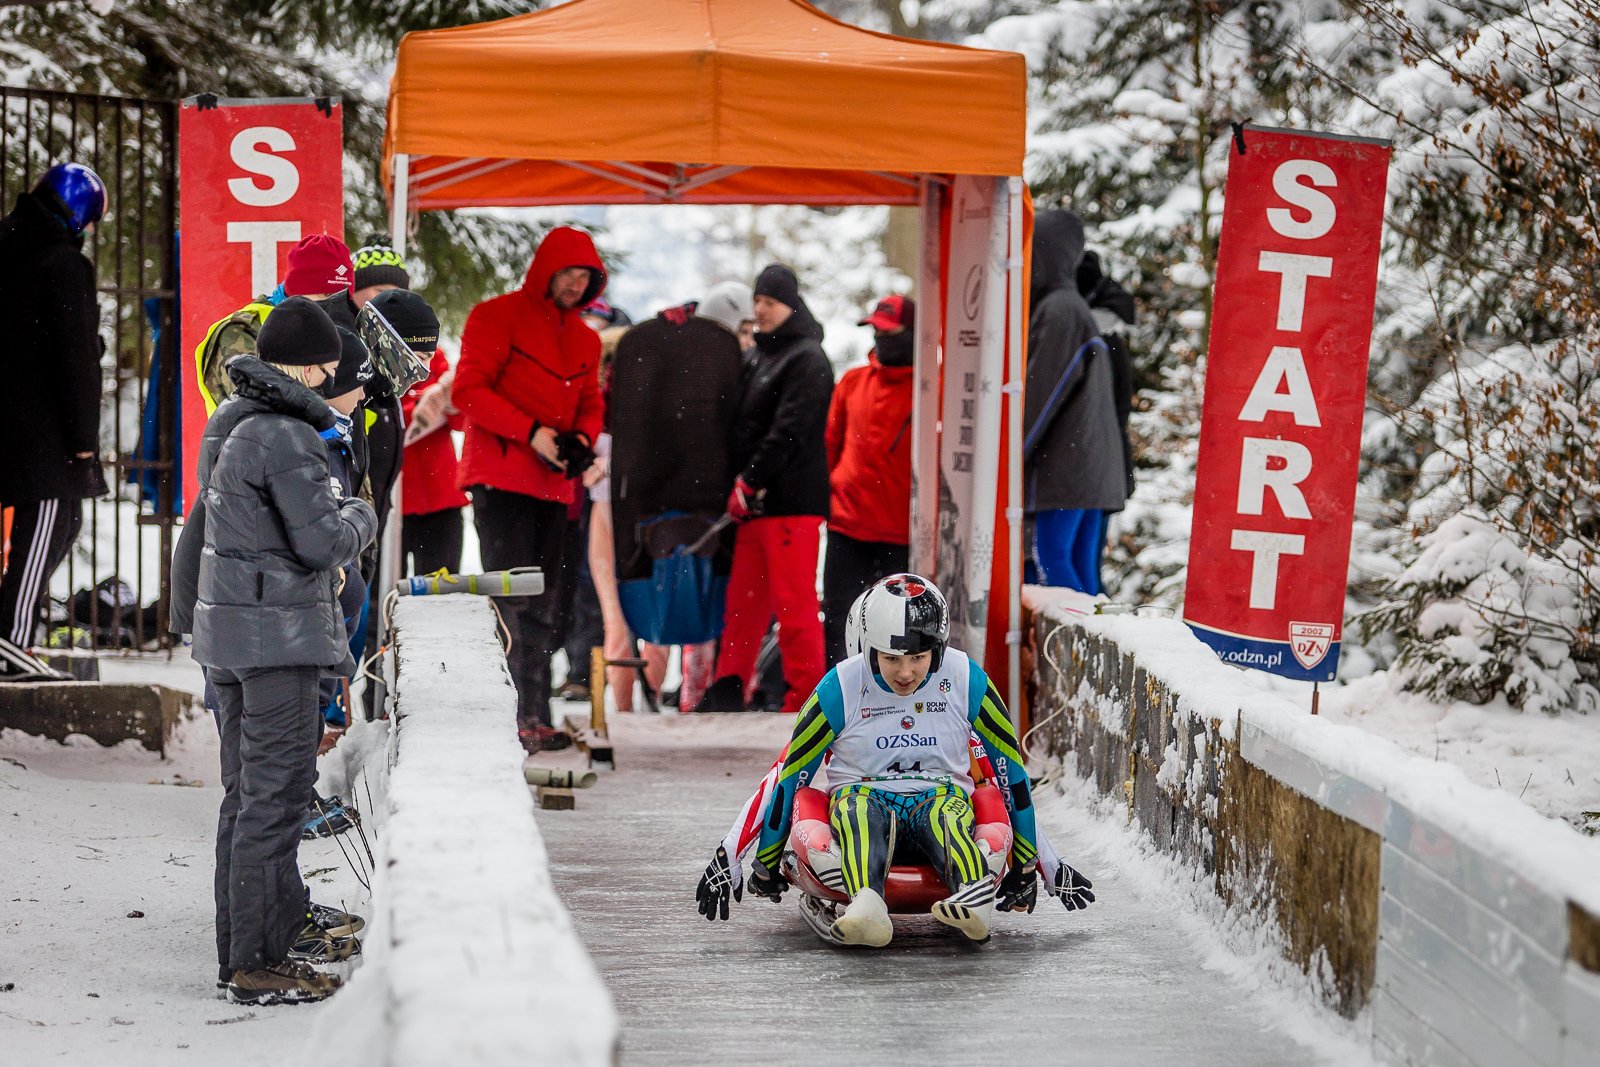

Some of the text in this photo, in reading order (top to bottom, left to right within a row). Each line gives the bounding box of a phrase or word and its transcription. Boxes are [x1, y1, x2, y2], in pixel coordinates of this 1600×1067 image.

[1230, 159, 1338, 611] START
[1301, 626, 1324, 635] 2002
[1297, 640, 1324, 657] DZN
[875, 734, 937, 749] OZSSan
